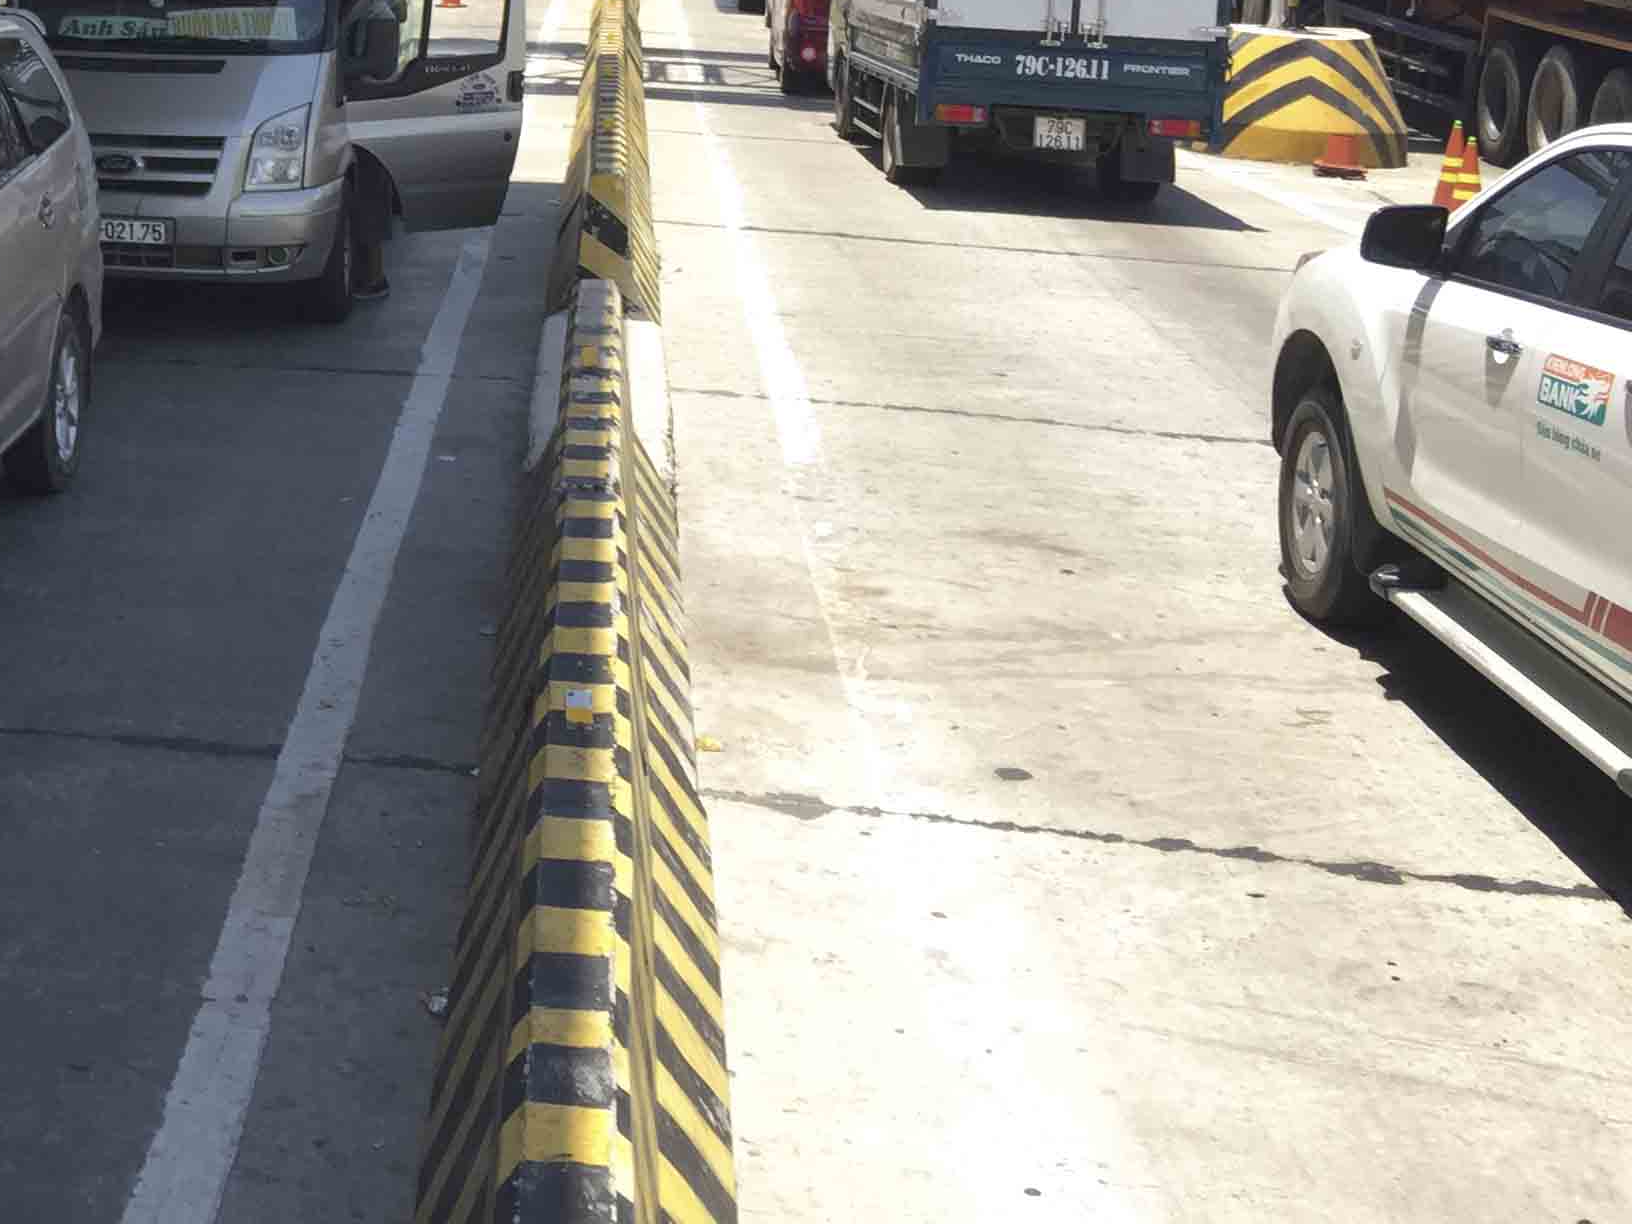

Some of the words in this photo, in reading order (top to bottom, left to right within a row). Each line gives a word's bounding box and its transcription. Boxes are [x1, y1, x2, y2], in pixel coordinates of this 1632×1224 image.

[955, 53, 1002, 65] THACO
[1122, 63, 1191, 76] FRONTIER
[1539, 376, 1578, 414] BANK
